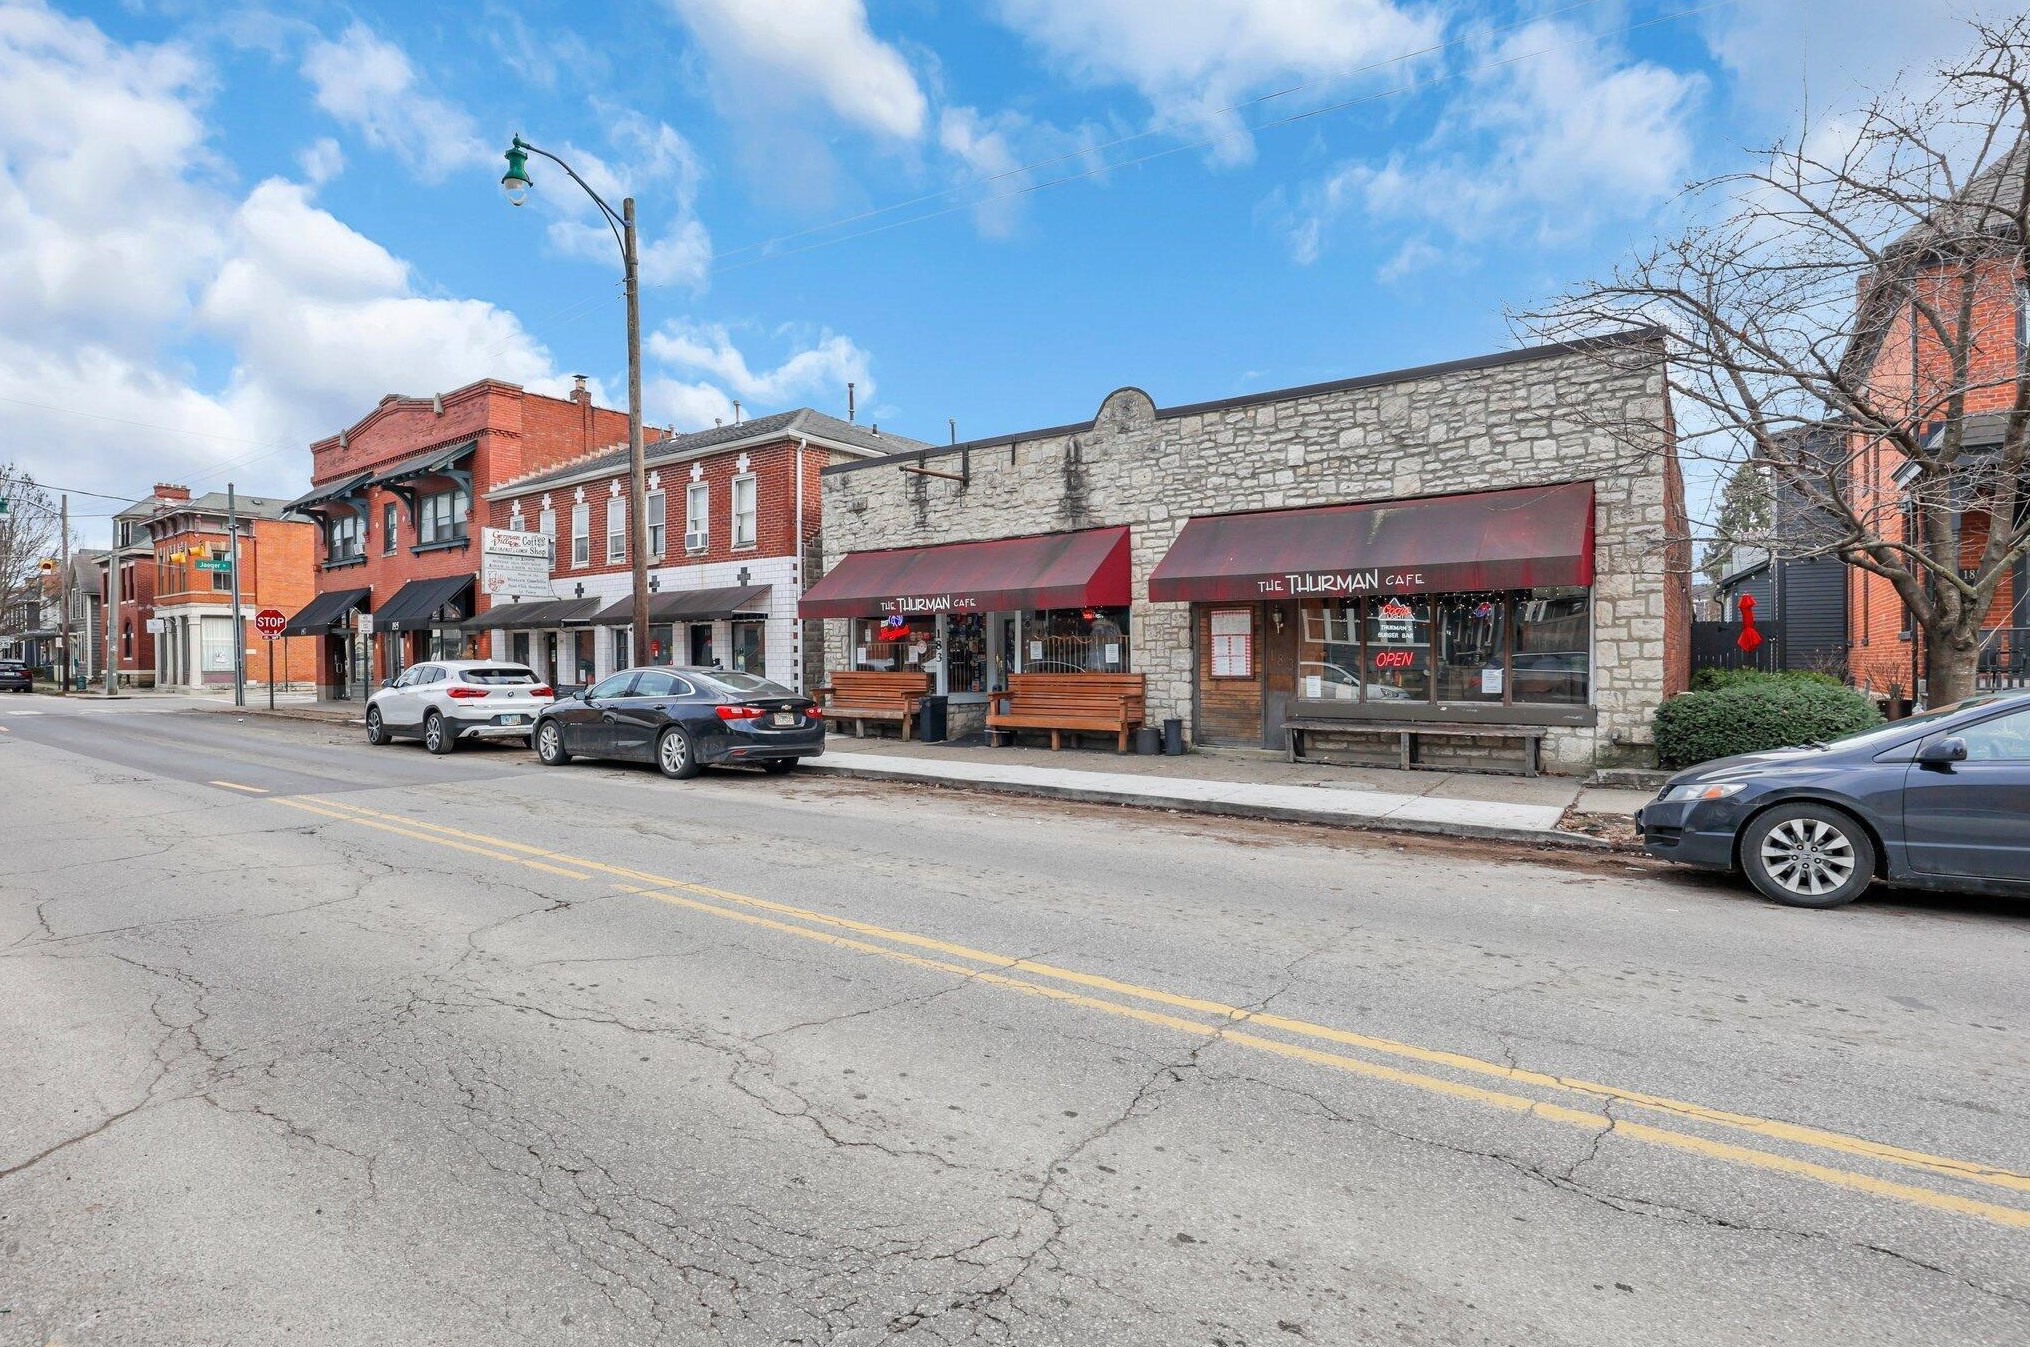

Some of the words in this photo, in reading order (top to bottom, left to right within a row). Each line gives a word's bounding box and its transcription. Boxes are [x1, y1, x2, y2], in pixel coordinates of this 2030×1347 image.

[522, 535, 546, 547] Coffee
[529, 546, 546, 556] Shop
[200, 561, 220, 569] Jaeger
[1257, 579, 1284, 593] THE
[1285, 569, 1379, 594] THURMAN
[1385, 573, 1425, 586] CAFE
[881, 601, 896, 611] THE
[896, 595, 950, 613] THURMAN
[953, 598, 976, 607] CAFE
[257, 617, 284, 627] STOP
[1376, 651, 1414, 667] OPEN
